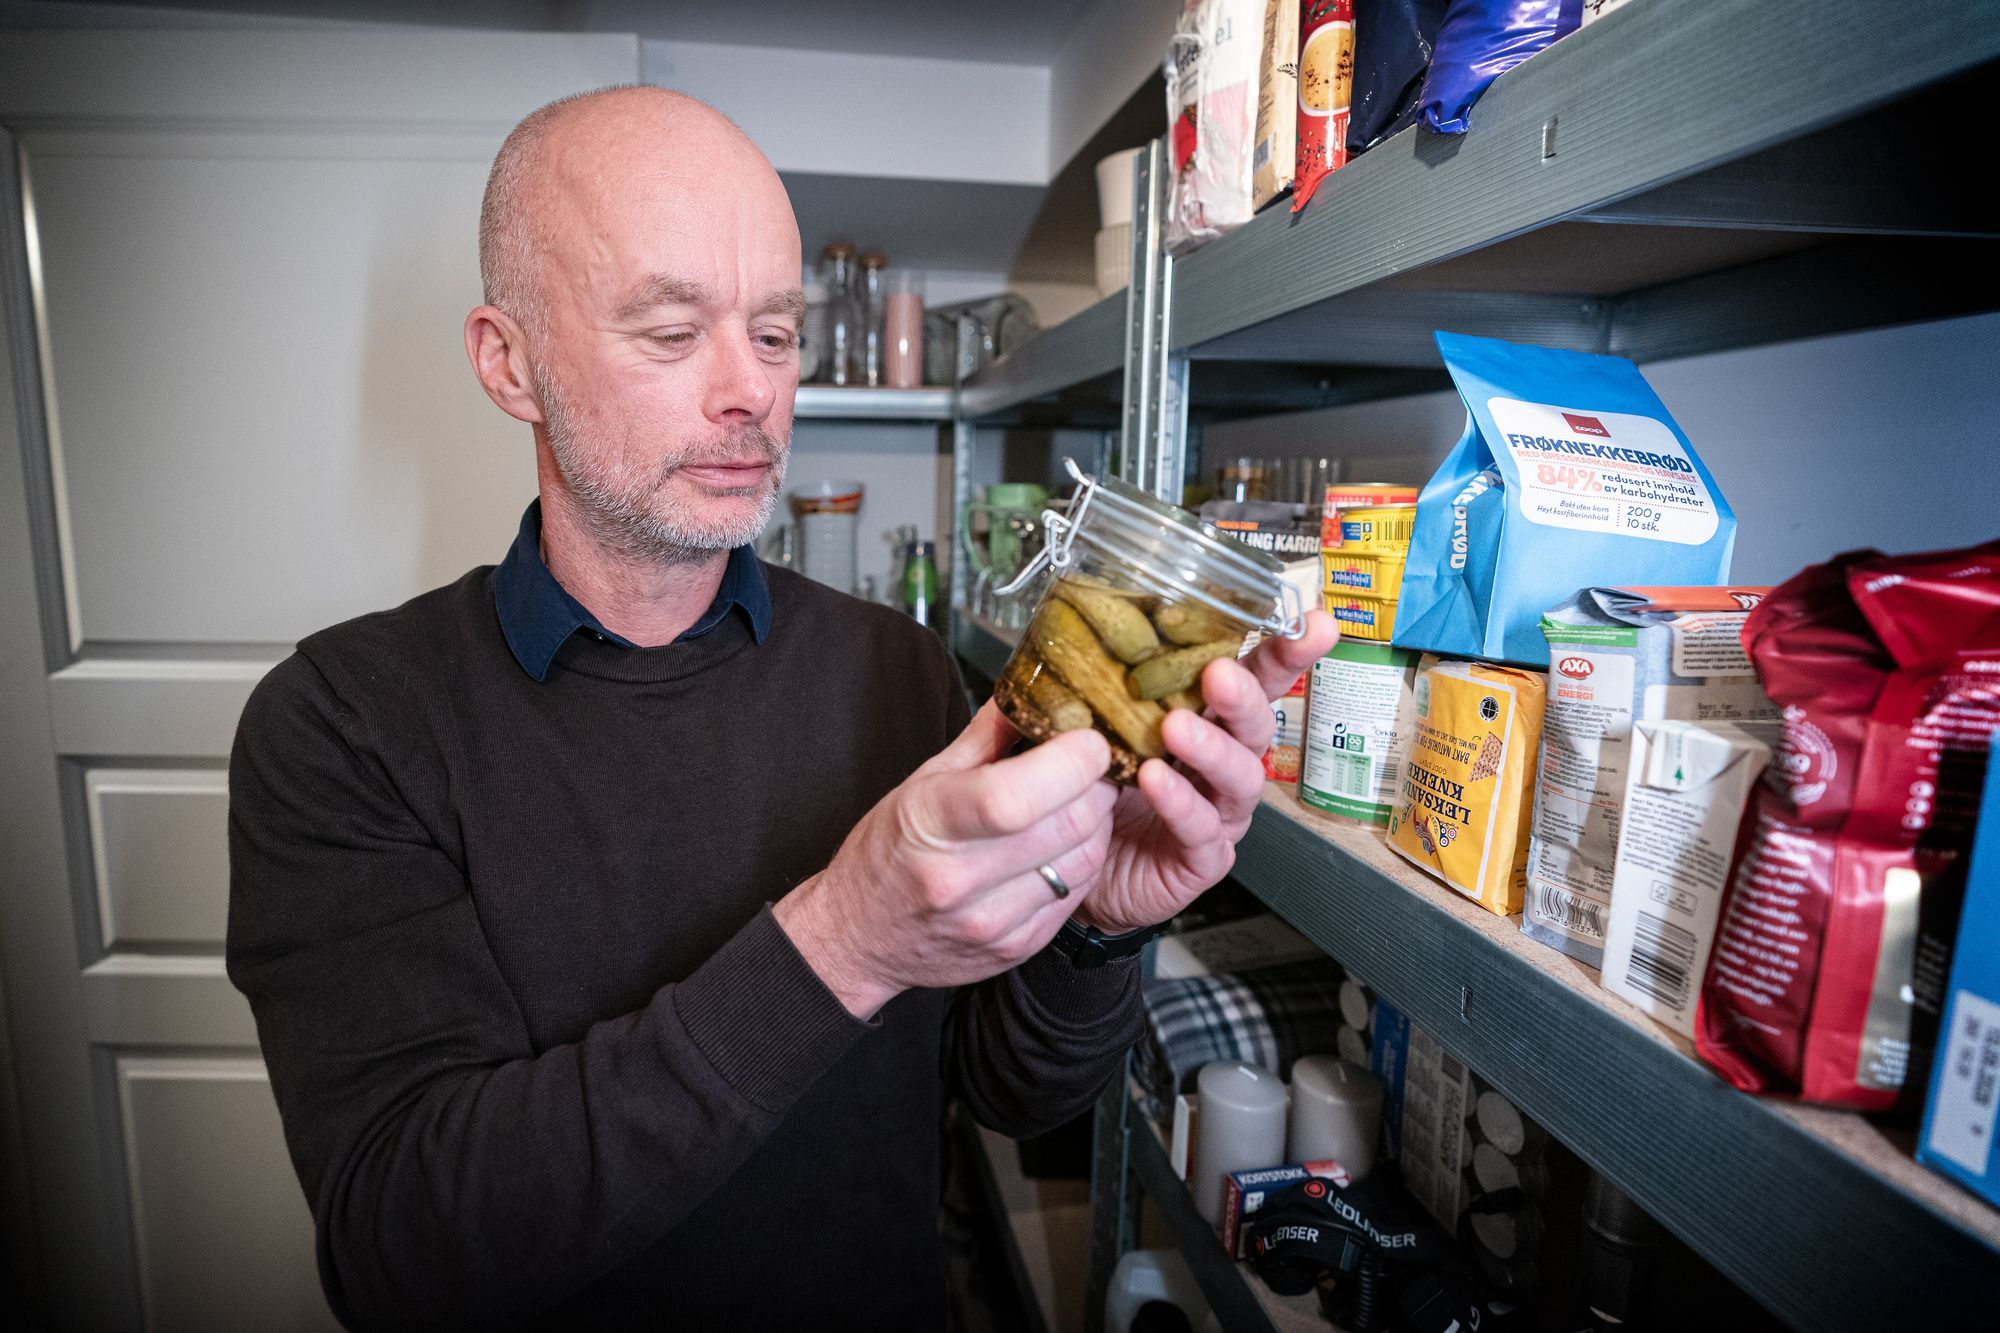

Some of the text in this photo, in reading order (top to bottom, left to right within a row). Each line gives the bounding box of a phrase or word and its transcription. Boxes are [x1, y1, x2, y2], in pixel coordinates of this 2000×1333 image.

[1575, 425, 1604, 435] coop
[1507, 433, 1693, 474] FRØKNEKKEBRØD
[1516, 449, 1541, 460] MED
[1641, 465, 1655, 475] OG
[1655, 467, 1699, 483] HAVSALT
[1536, 463, 1603, 492] 84%
[1602, 473, 1696, 496] redusert innhold
[1604, 485, 1705, 508] av karbohydrater
[1536, 504, 1610, 521] Høyt kostfiberinnhold
[1560, 499, 1610, 513] Bakt uten korn
[1626, 505, 1662, 521] 200 g
[1626, 518, 1660, 532] 10 stk.
[1561, 658, 1591, 674] AXA
[1451, 748, 1471, 765] BAKT
[1406, 761, 1465, 800] KNEKKE
